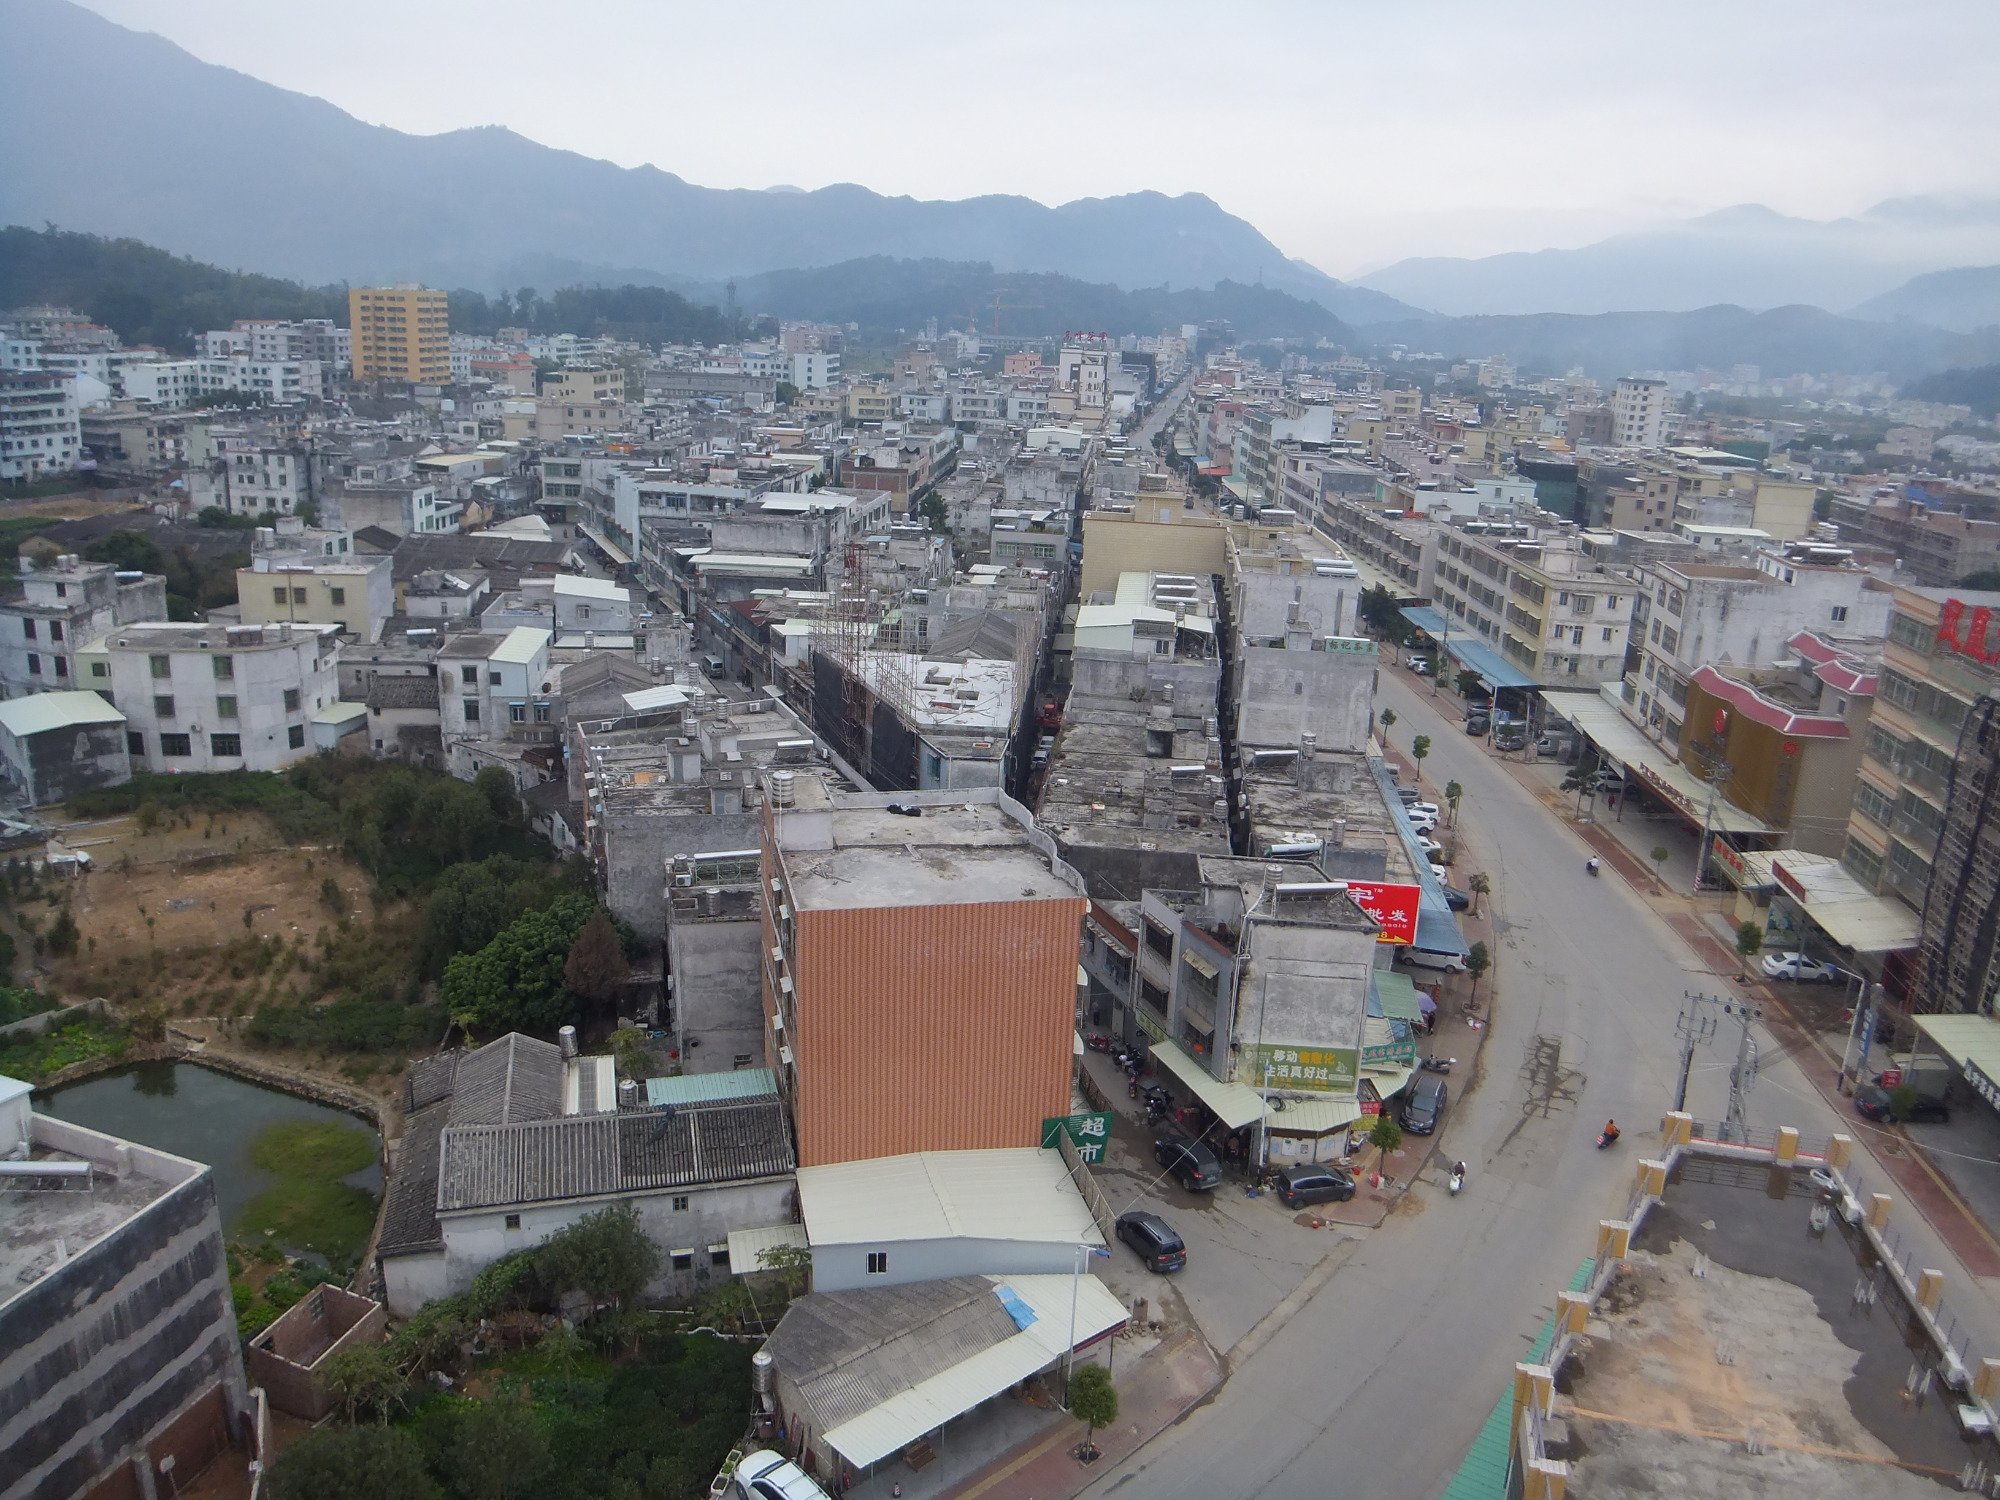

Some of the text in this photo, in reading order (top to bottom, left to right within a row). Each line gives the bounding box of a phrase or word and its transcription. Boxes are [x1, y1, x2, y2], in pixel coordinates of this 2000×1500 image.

[1364, 907, 1408, 923] 批发
[1266, 1064, 1328, 1080] 生活真好过
[1079, 1117, 1105, 1162] 超市
